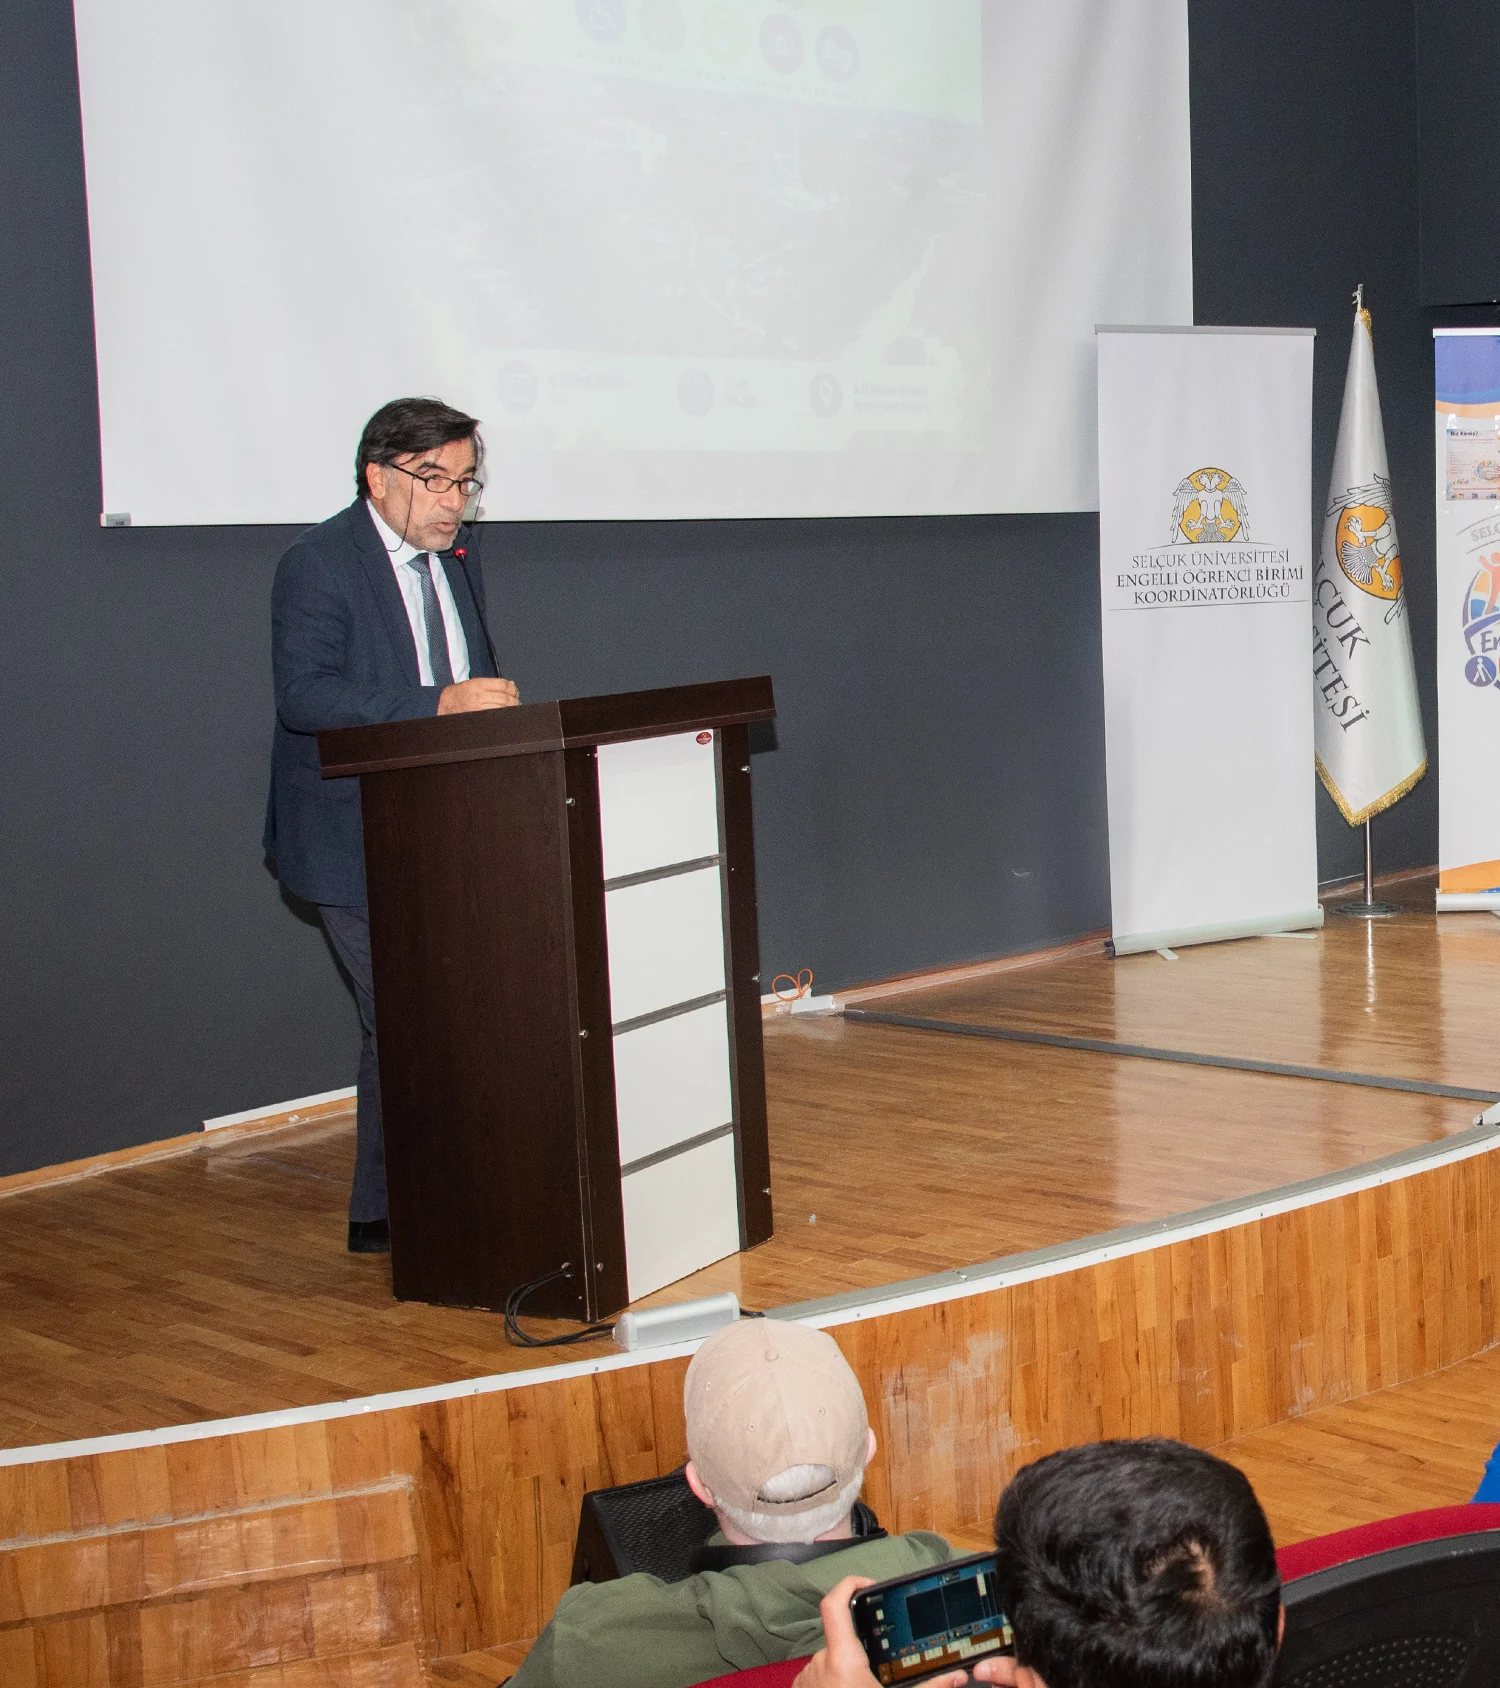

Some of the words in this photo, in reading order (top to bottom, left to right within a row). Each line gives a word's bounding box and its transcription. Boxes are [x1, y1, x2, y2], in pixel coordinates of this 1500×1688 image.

[1132, 553, 1188, 571] SELÇUK
[1191, 548, 1290, 567] ÜNİVERSİTESİ
[1116, 569, 1179, 588] ENGELLİ
[1182, 567, 1252, 585] ÖĞRENCİ
[1256, 565, 1304, 582] BİRİMİ
[1133, 582, 1291, 605] KOORDİNATÖRLÜĞÜ
